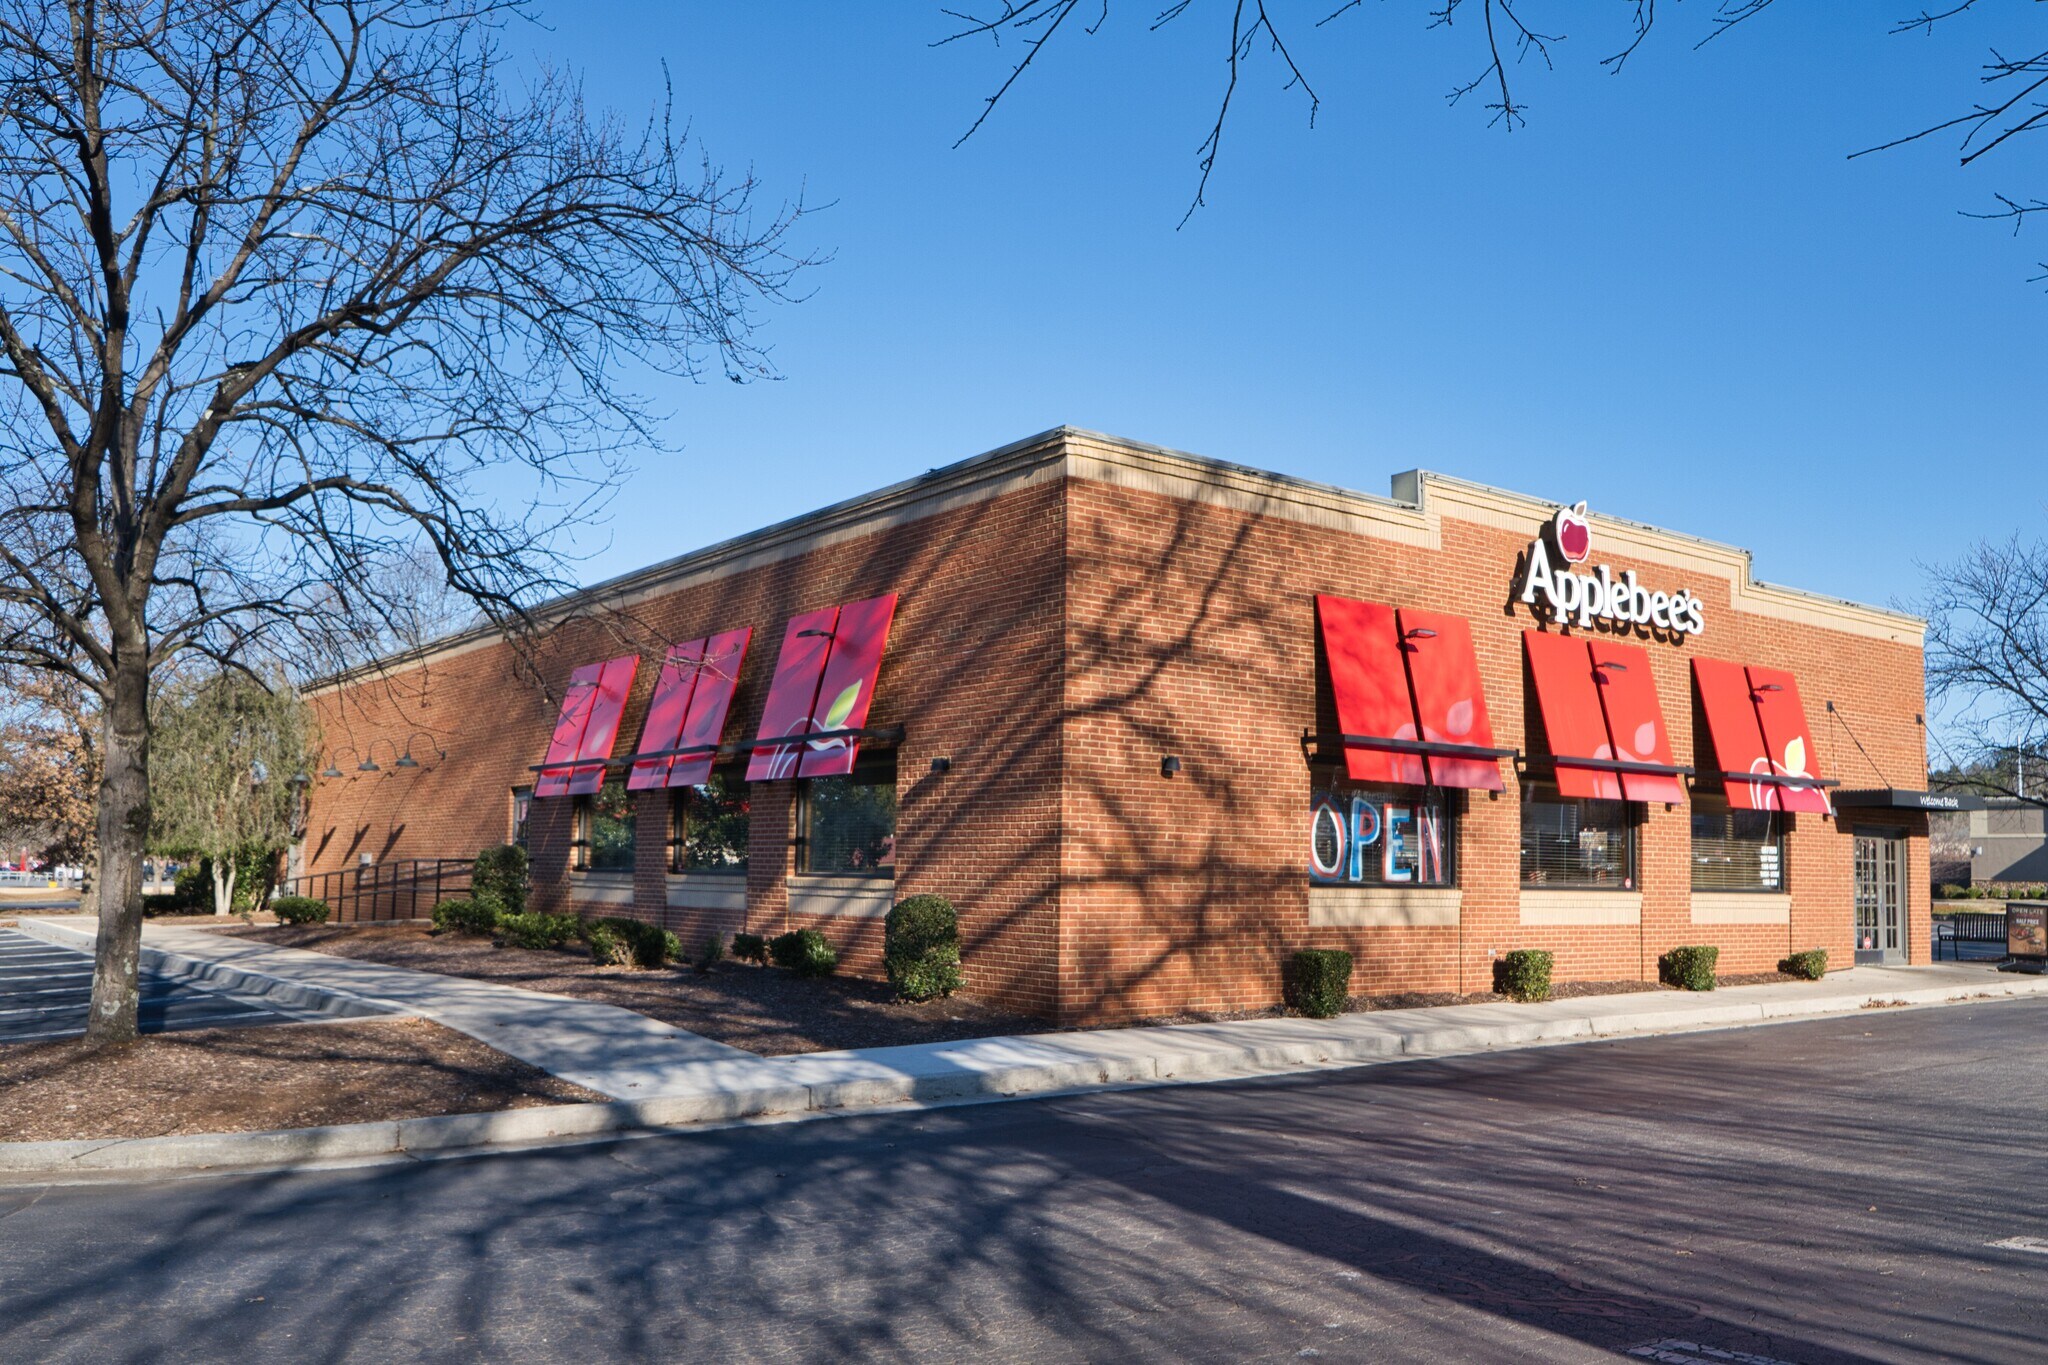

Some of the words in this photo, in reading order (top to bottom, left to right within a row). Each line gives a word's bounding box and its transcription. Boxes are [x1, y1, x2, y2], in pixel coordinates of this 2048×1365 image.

[1521, 538, 1704, 635] Applebee's
[1309, 791, 1441, 882] OPEN
[1920, 795, 1943, 807] Welcome
